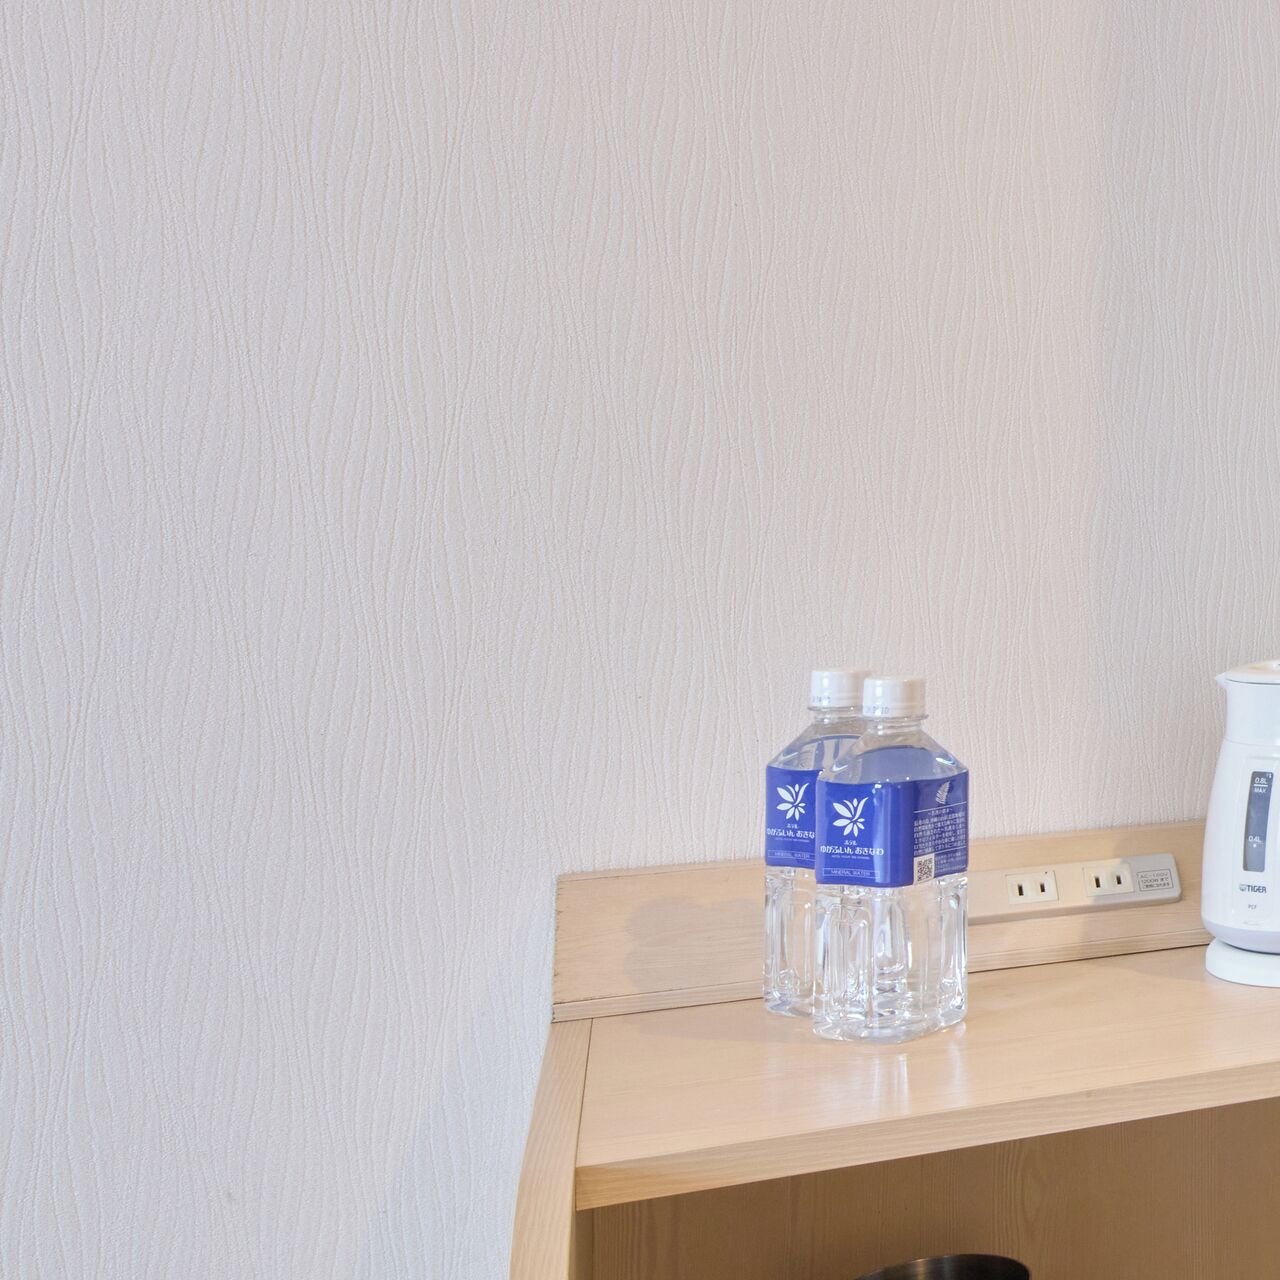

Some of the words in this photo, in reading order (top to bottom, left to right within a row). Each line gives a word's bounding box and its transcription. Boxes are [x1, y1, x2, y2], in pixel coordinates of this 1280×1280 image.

[796, 830, 815, 839] おきな
[1247, 884, 1267, 893] TIGER
